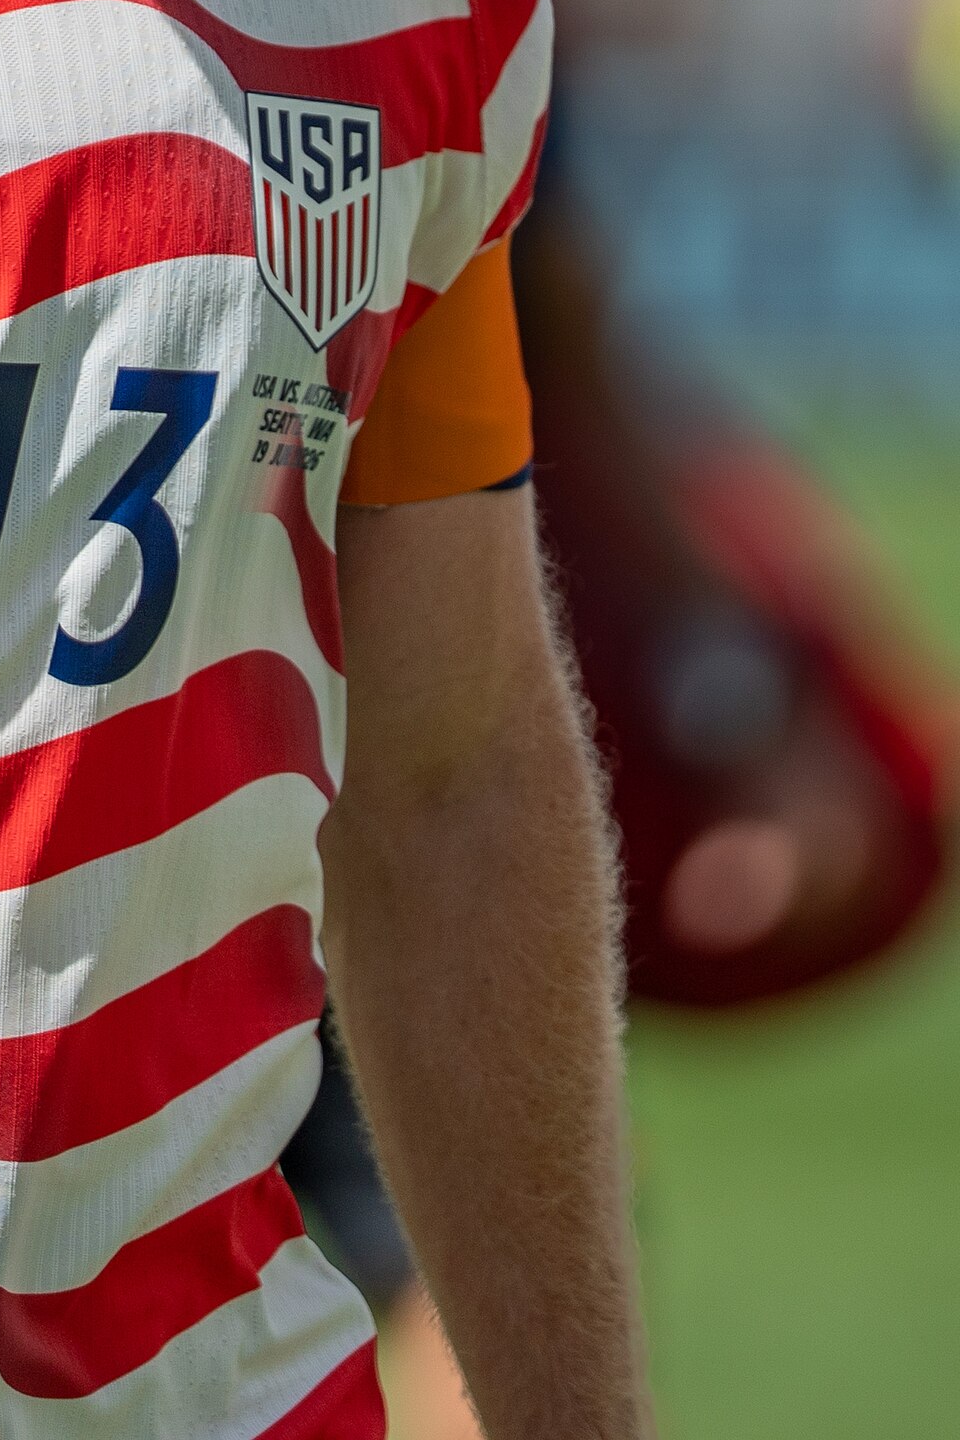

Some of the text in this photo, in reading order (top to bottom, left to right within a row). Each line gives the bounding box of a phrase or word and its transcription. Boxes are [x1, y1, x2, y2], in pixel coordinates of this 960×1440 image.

[257, 106, 372, 205] USA
[252, 373, 278, 400] USA
[307, 416, 337, 443] WA
[251, 439, 270, 464] 19
